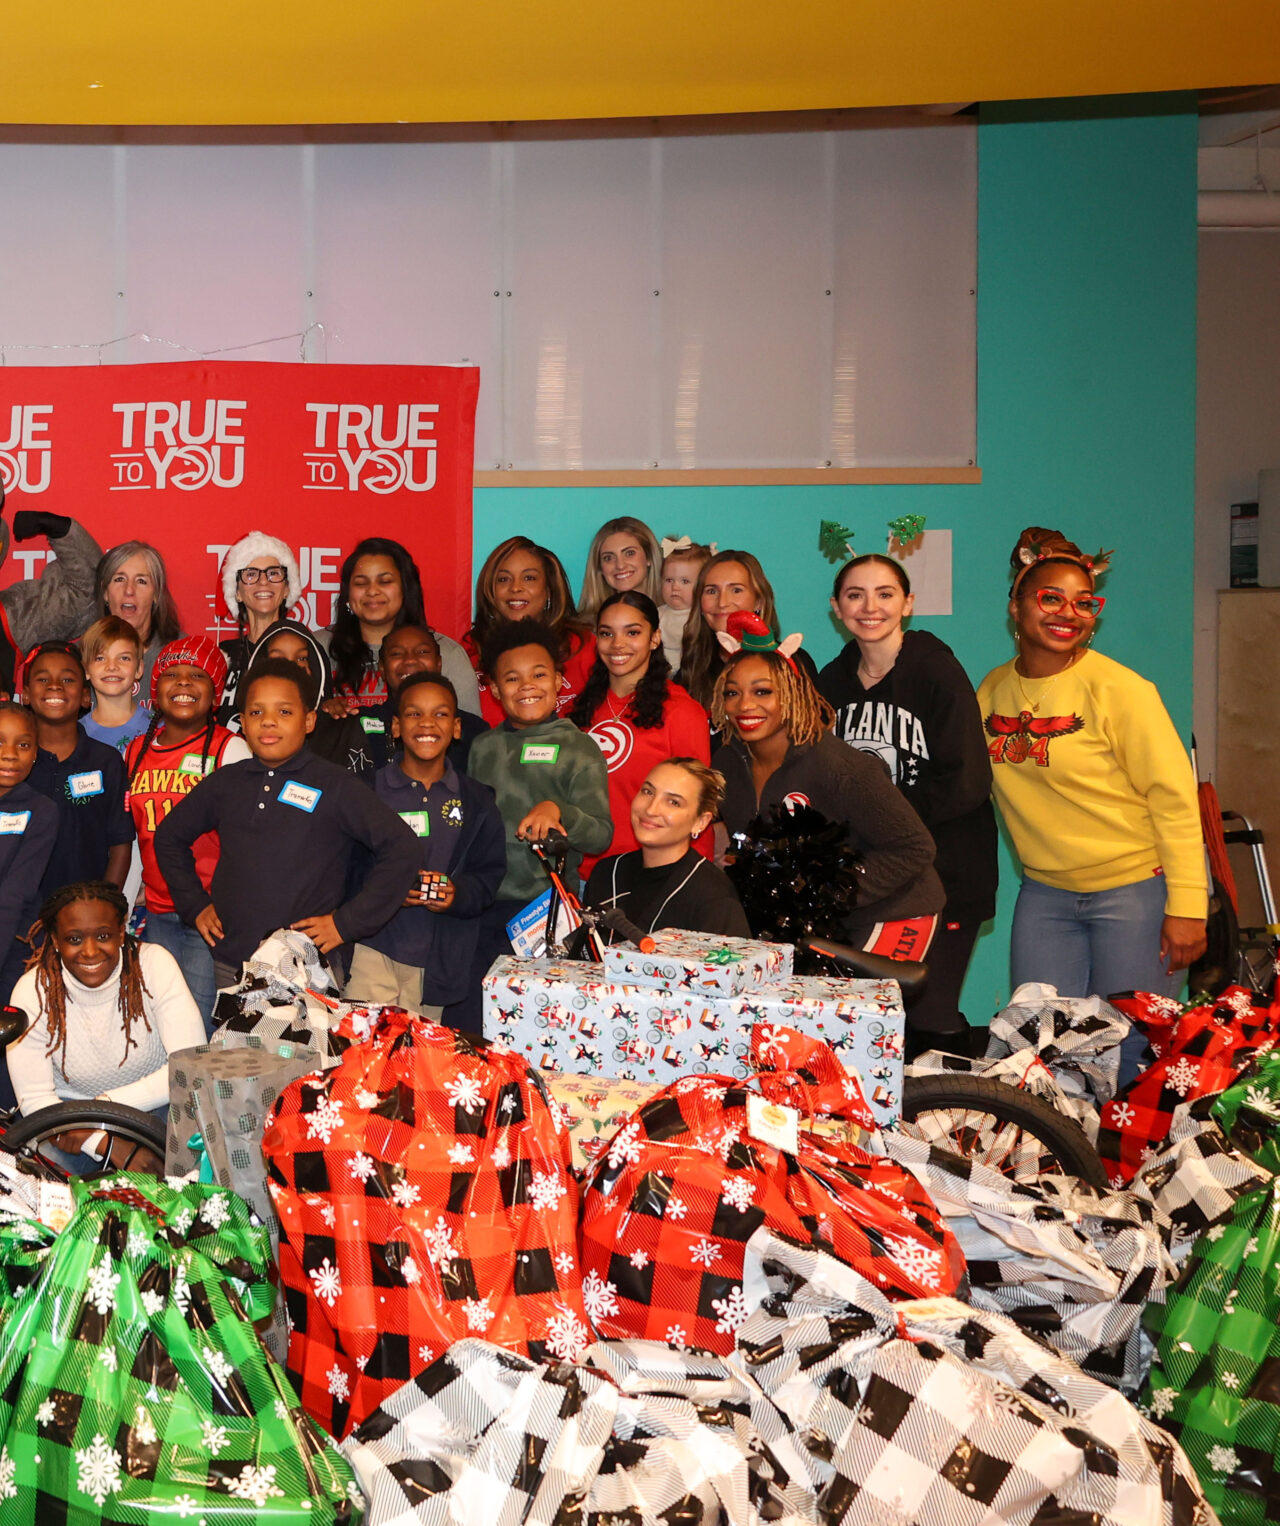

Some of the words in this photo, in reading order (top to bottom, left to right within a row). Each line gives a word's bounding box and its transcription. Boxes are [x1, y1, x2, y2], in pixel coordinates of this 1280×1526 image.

[113, 400, 247, 448] TRUE
[305, 403, 439, 449] TRUE
[114, 462, 142, 483] TO
[145, 446, 244, 491] YOU
[307, 463, 335, 484] TO
[337, 448, 437, 494] YOU
[206, 545, 341, 591] TUE
[833, 701, 929, 760] LANTA
[527, 921, 547, 937] mongo
[891, 926, 919, 957] ATL
